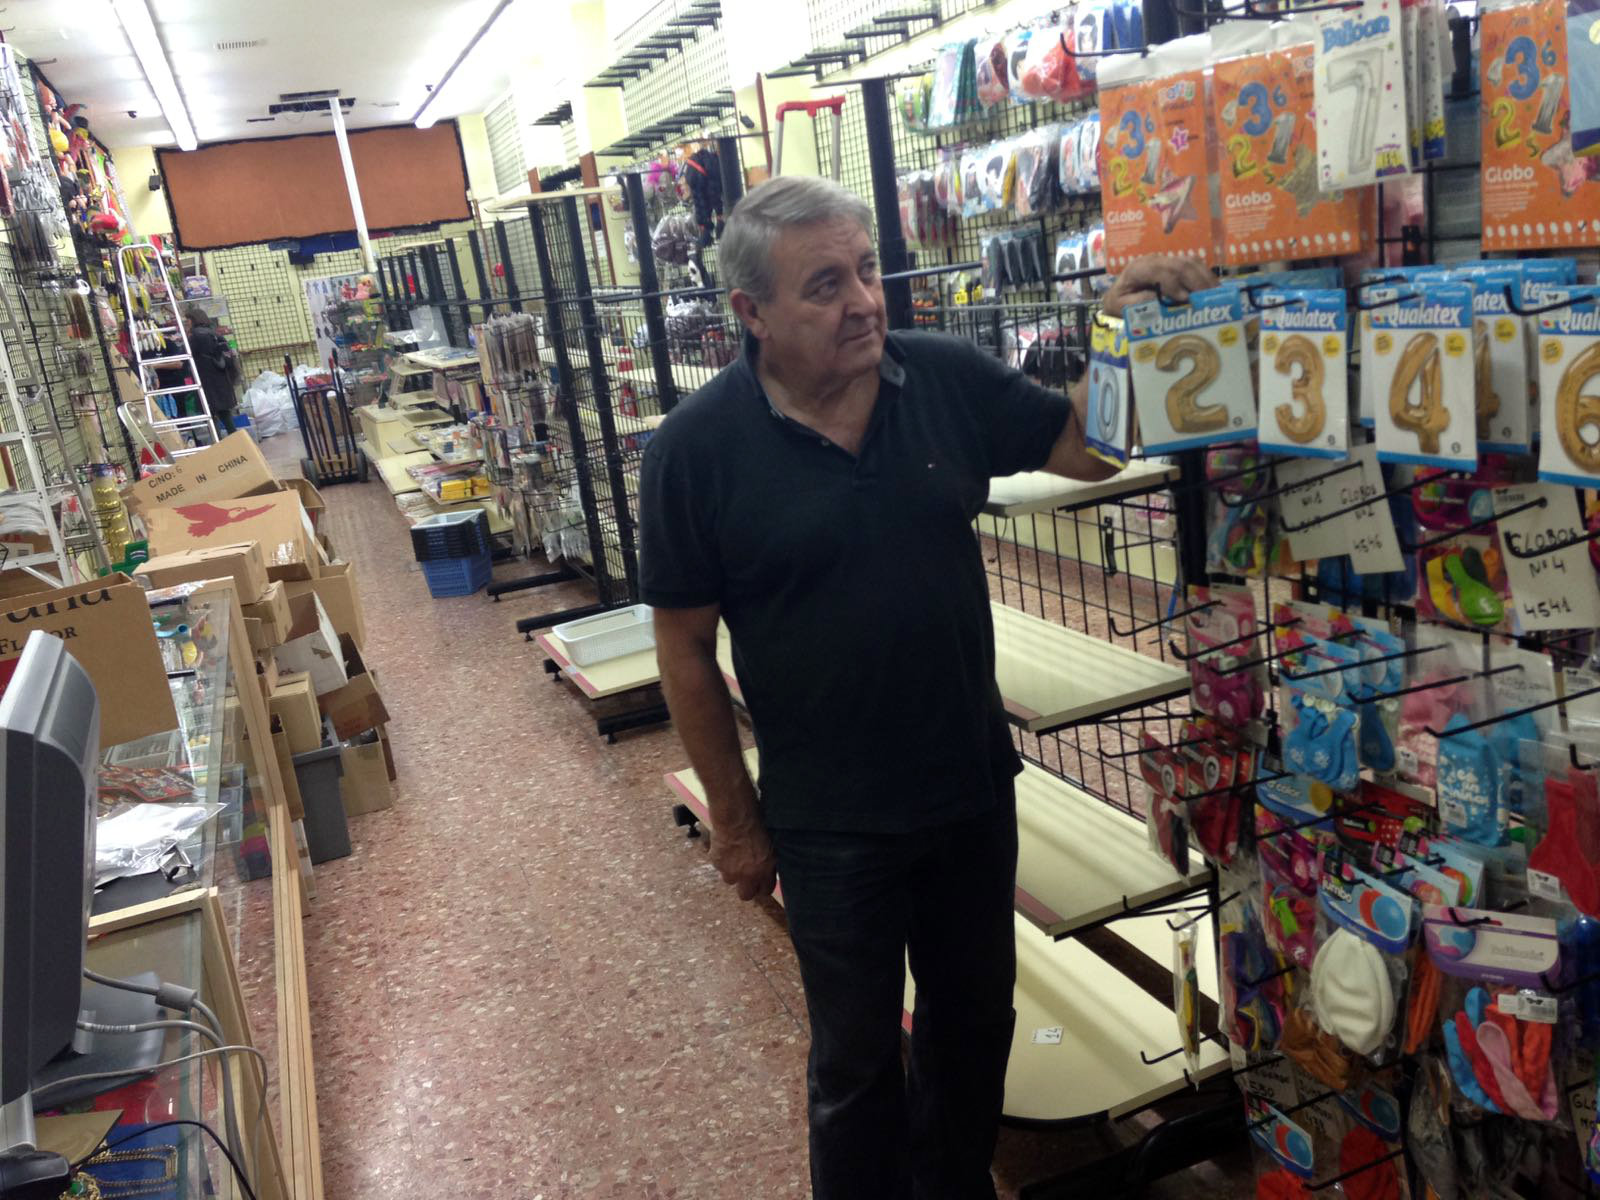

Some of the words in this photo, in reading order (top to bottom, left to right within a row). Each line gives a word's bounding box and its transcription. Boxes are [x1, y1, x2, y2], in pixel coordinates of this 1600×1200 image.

[1485, 164, 1535, 184] Globo
[1225, 191, 1273, 209] Globo
[1106, 208, 1145, 225] Globo
[1151, 304, 1234, 335] Qualatex
[1276, 304, 1338, 331] Qualatex
[1388, 303, 1463, 328] Qualatex
[1155, 333, 1230, 434] 2
[1274, 334, 1326, 445] 3
[1388, 332, 1451, 455] 4
[155, 483, 186, 503] MADE
[195, 473, 208, 484] IN
[217, 454, 249, 474] CHINA
